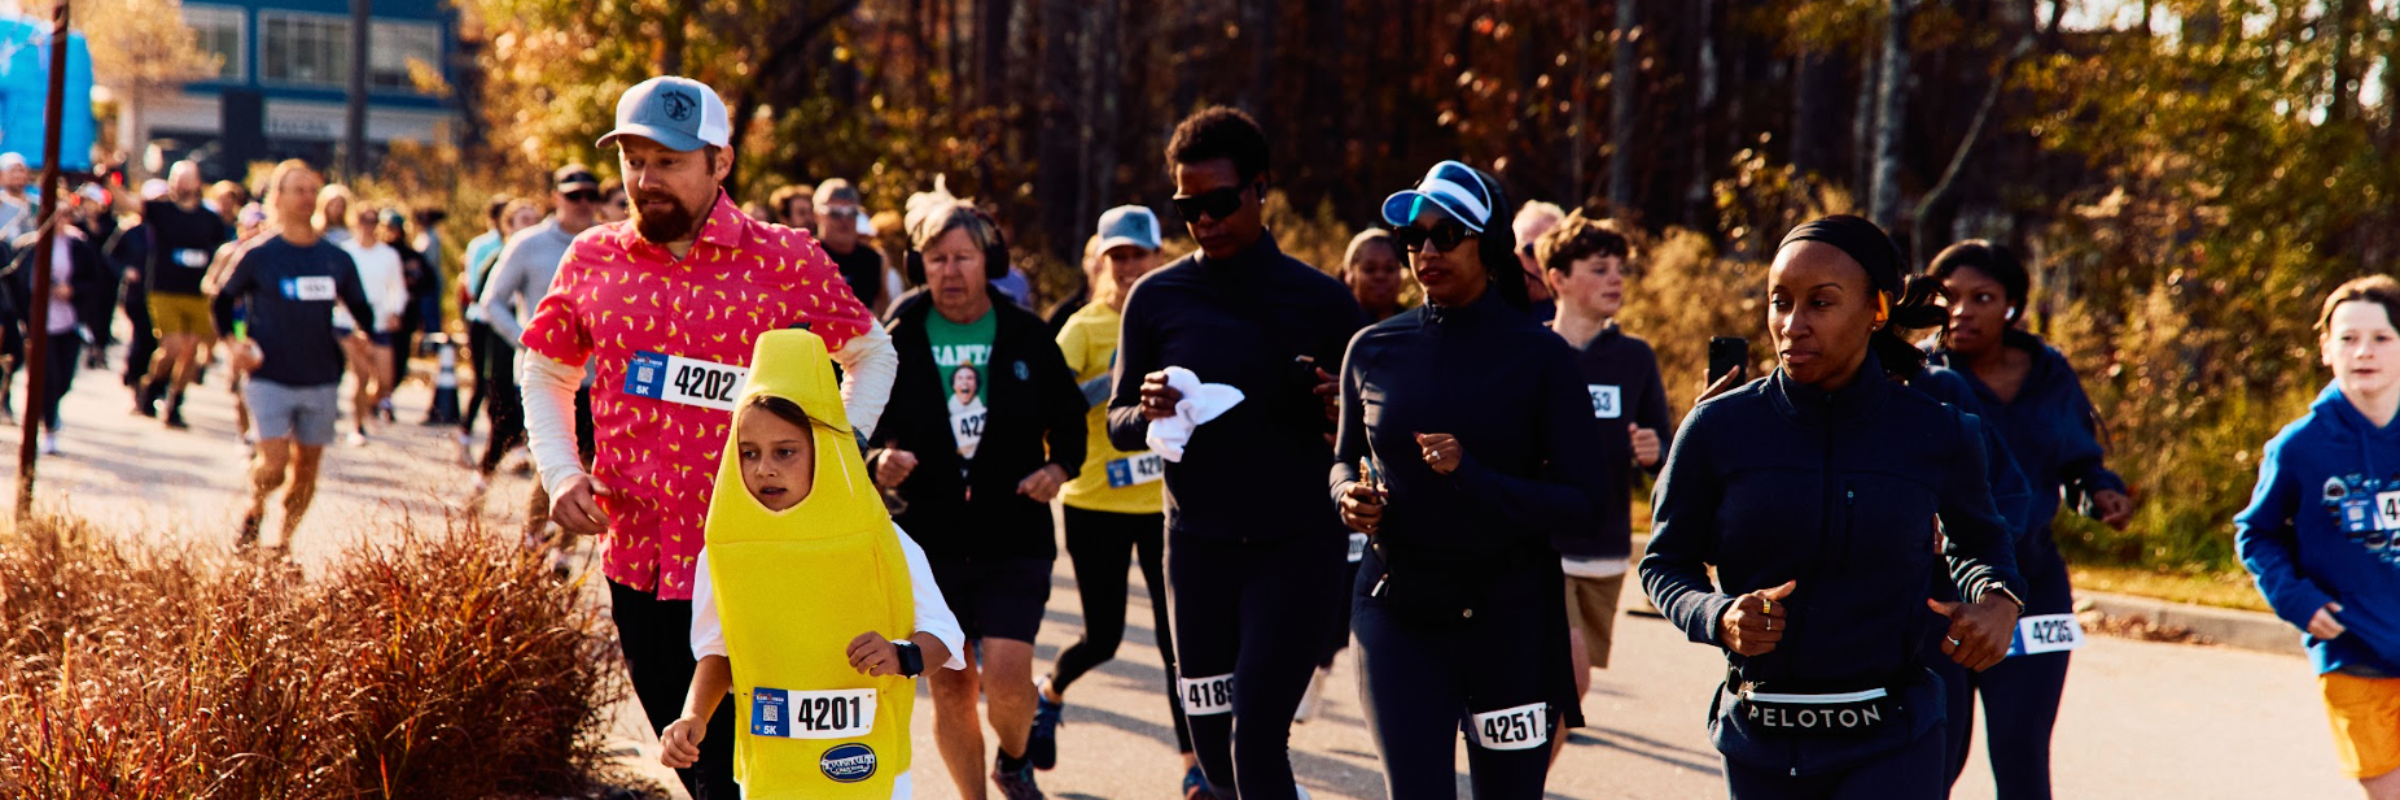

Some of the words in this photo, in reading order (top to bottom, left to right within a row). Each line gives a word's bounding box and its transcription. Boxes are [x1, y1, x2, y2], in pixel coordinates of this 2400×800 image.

[636, 385, 650, 396] 5K
[674, 365, 737, 402] 4202
[2386, 498, 2400, 521] 4
[798, 696, 861, 731] 4201
[1748, 704, 1881, 728] PELOTON
[763, 725, 777, 735] 5K
[1484, 710, 1538, 743] 4251
